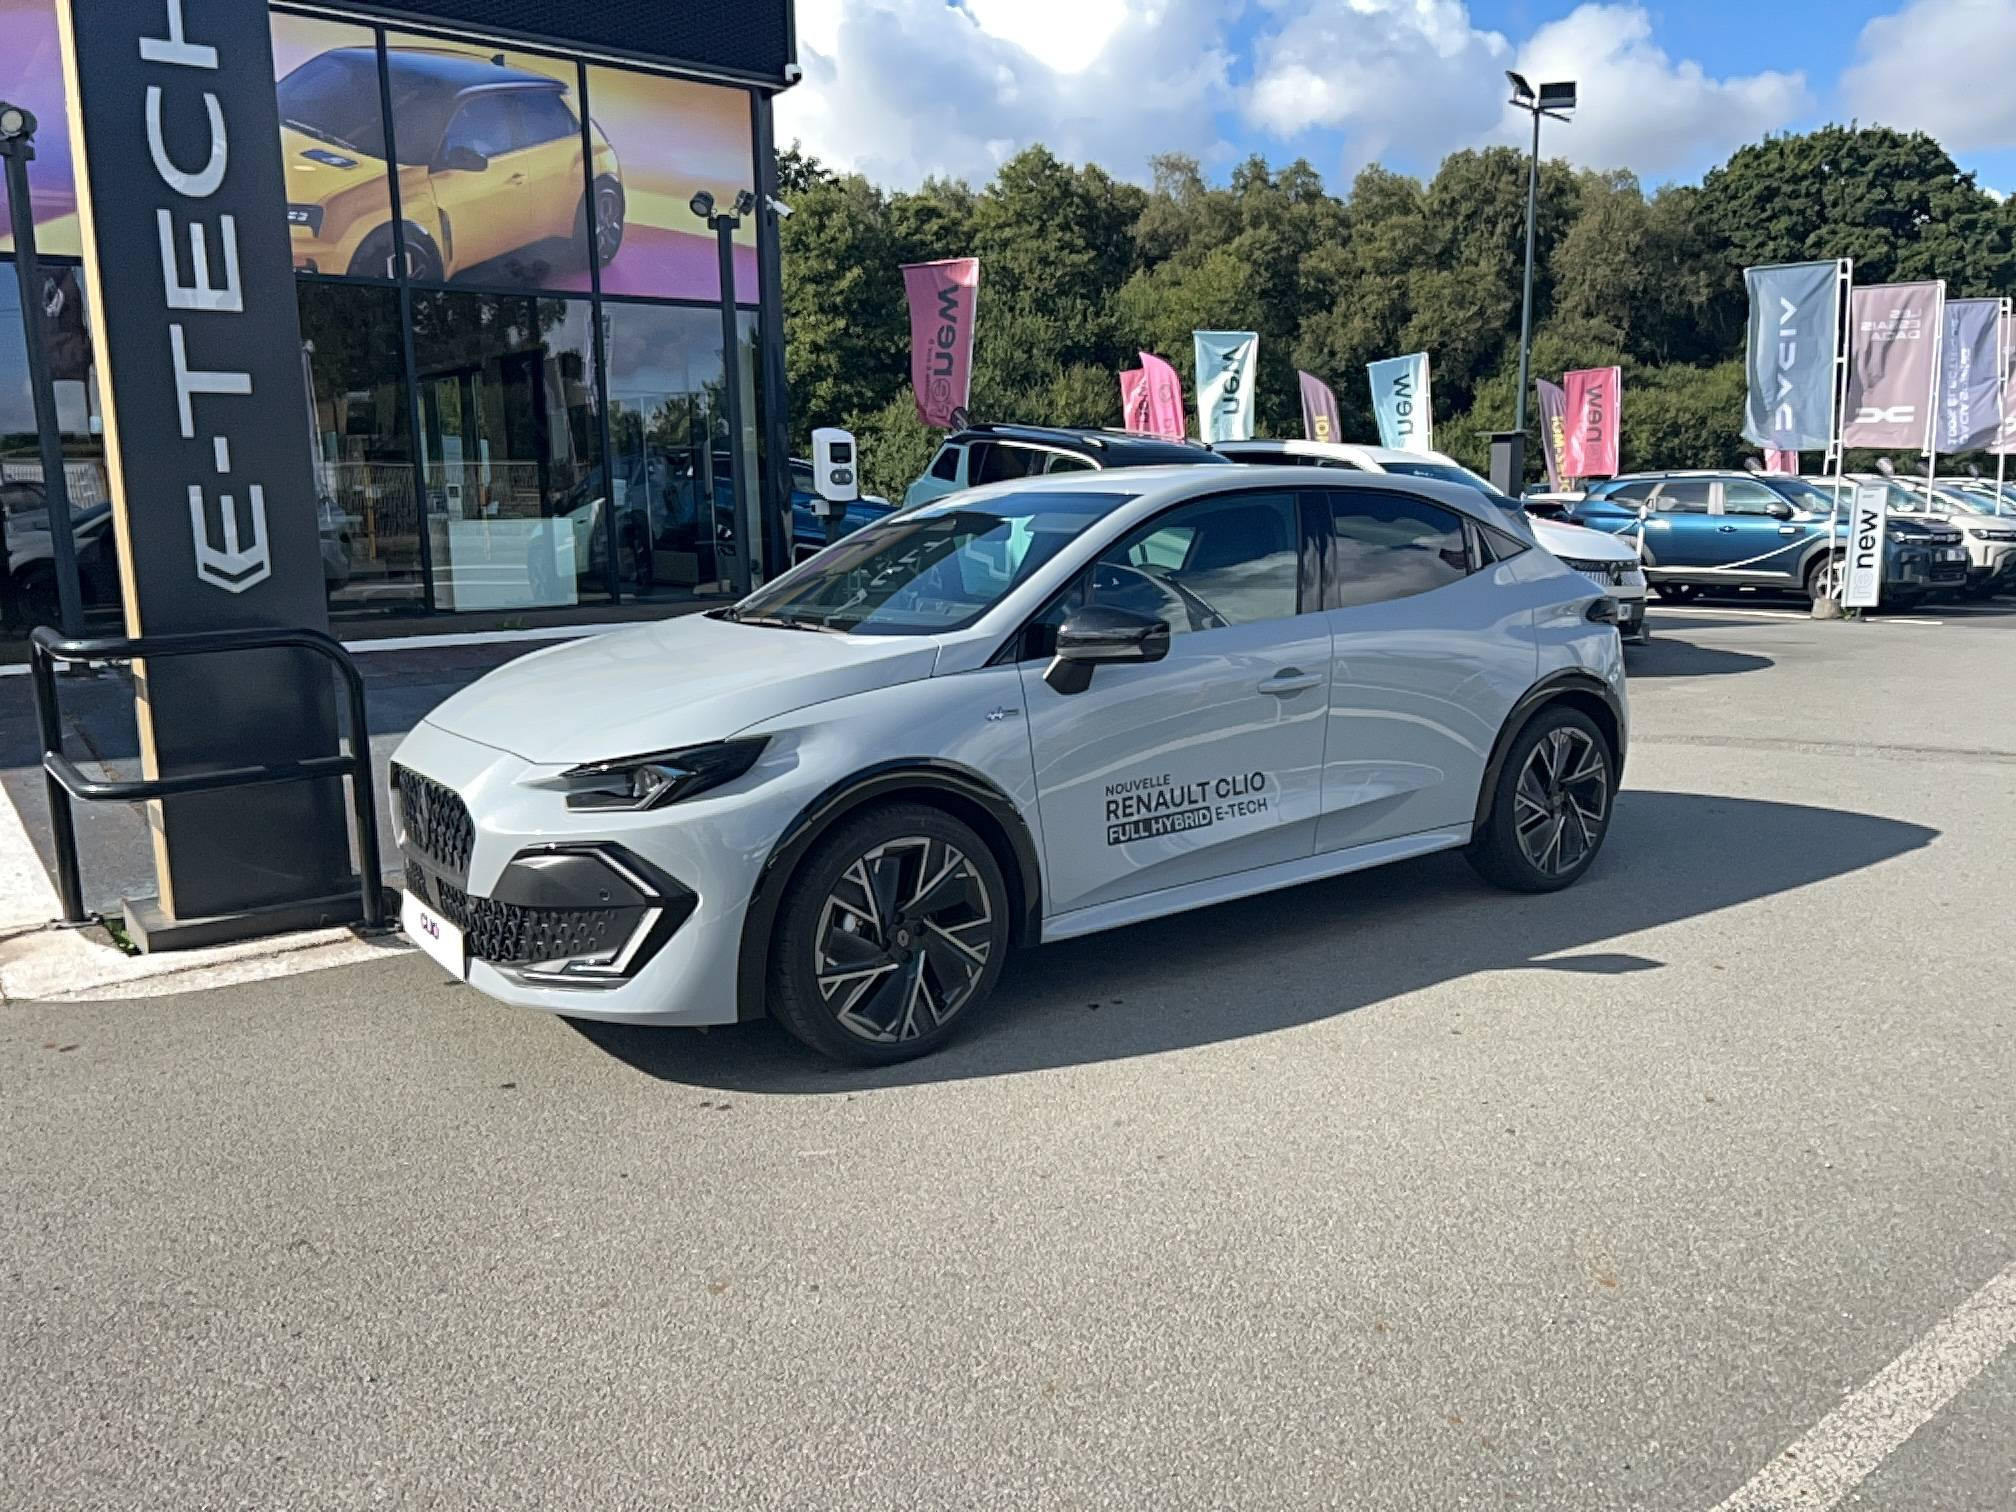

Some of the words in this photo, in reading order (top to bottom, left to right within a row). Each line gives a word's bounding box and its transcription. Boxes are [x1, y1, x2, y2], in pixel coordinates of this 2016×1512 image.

[1105, 774, 1171, 797] NOUVELLE
[1106, 781, 1210, 822] RENAULT
[1215, 771, 1266, 799] CLIO
[1109, 823, 1150, 844] FULL
[1151, 810, 1211, 835] HYBRID
[1215, 797, 1269, 821] E-TECH
